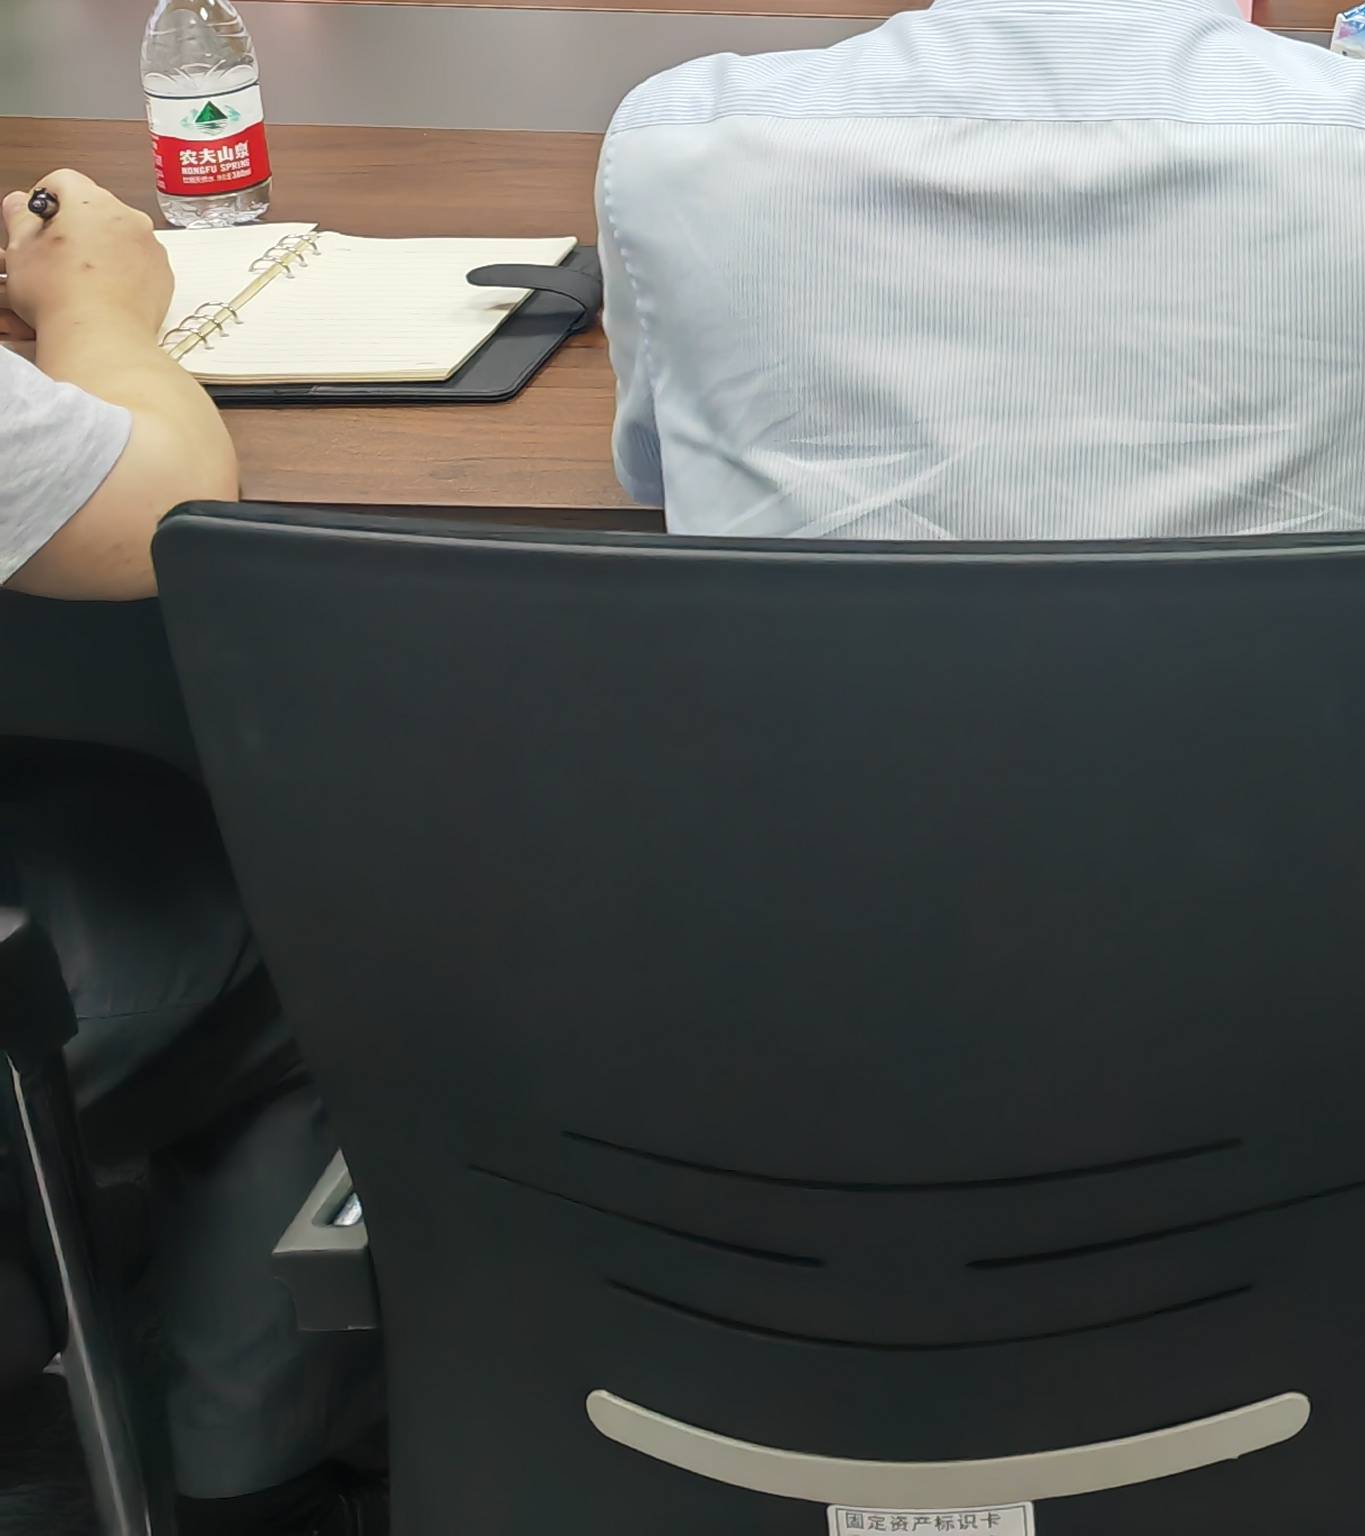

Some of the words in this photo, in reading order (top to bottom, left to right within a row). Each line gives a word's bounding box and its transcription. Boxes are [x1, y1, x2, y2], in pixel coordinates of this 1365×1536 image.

[179, 140, 250, 166] 农夫山泉
[846, 1511, 1001, 1532] 固定资产标识卡
